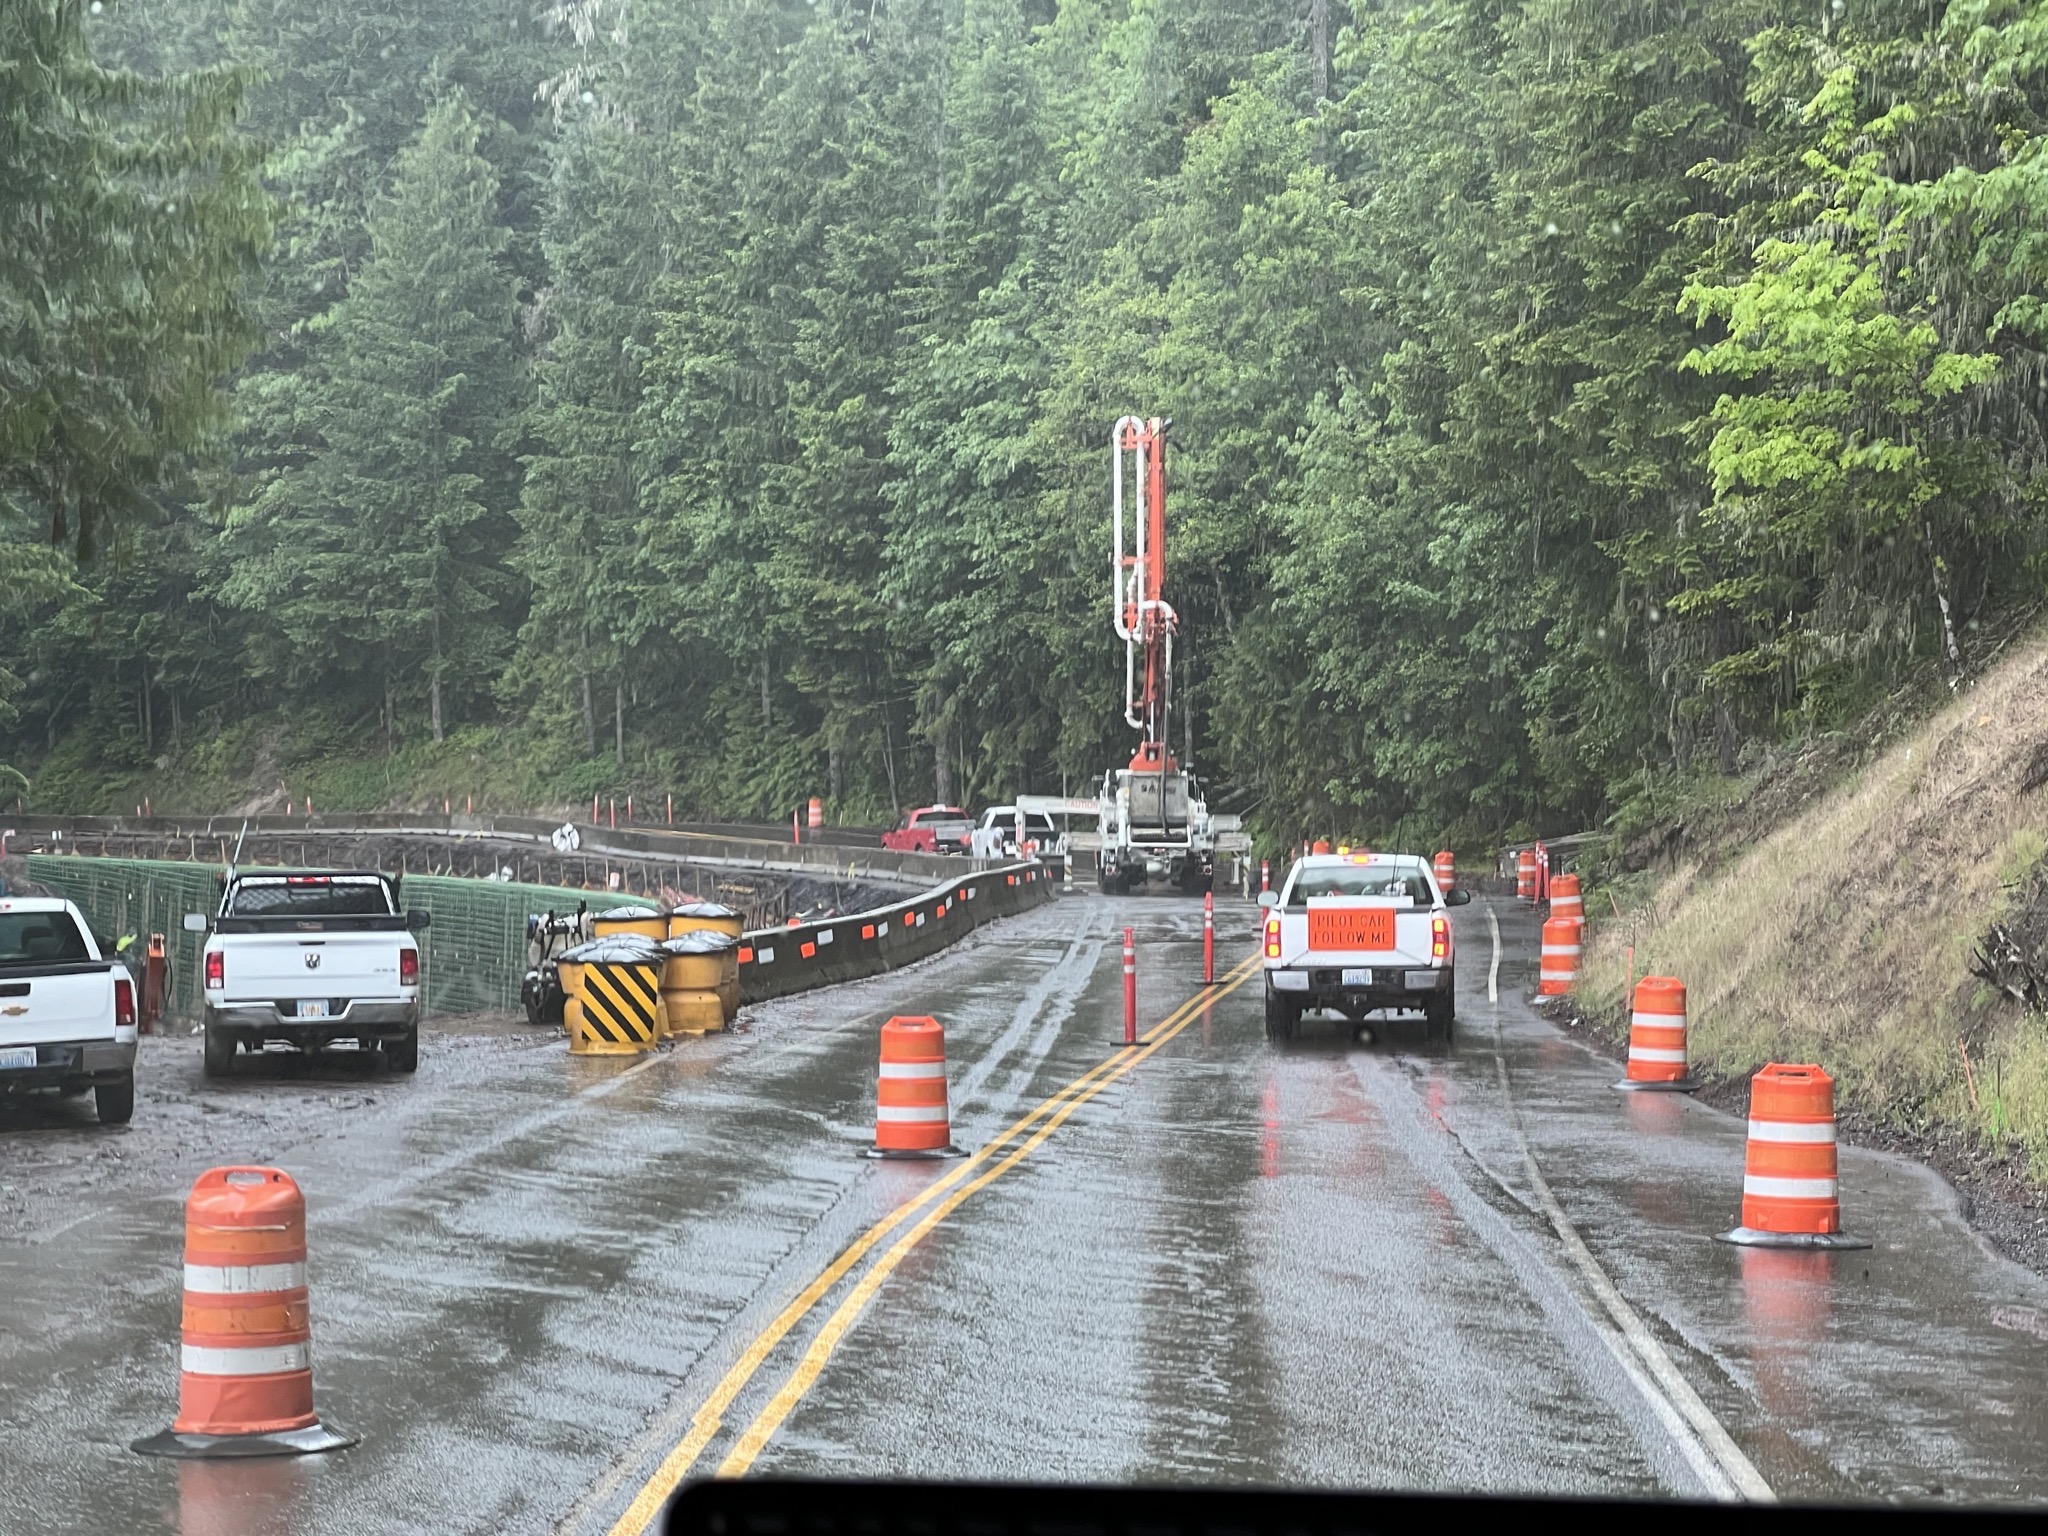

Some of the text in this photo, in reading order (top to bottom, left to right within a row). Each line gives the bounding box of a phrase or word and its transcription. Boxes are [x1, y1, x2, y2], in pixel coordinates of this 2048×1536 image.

[1316, 914, 1386, 928] PILOT CAR
[1314, 931, 1390, 945] FOLLOW ME
